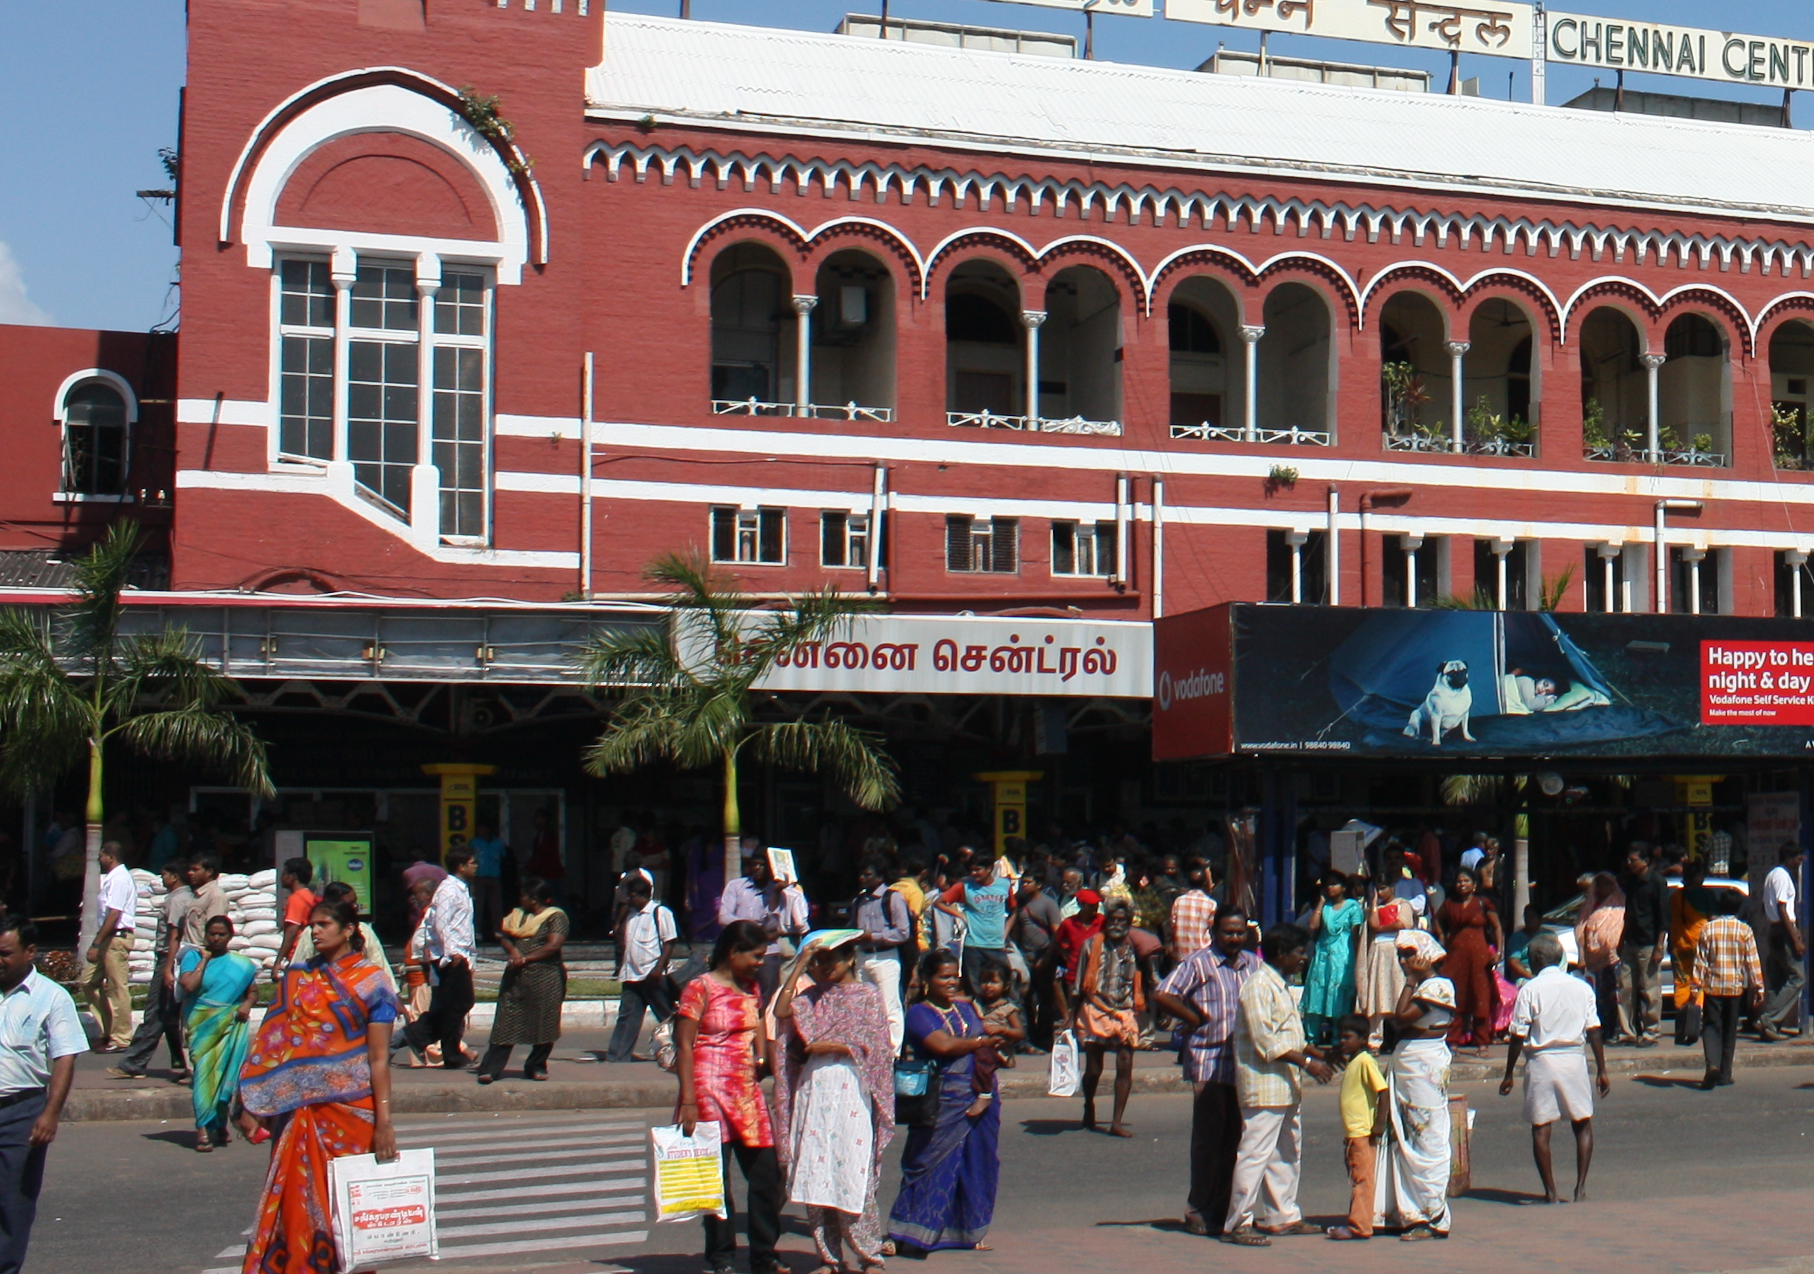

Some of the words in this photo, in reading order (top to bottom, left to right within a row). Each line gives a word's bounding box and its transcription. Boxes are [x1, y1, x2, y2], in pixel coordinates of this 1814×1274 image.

[1552, 18, 1707, 75] CHENNAI
[933, 633, 1118, 682] சென்ட்ரல்
[1708, 647, 1766, 669] Happy
[1769, 650, 1788, 666] to
[1173, 667, 1225, 701] vodafone
[1708, 672, 1756, 693] night
[1760, 672, 1774, 689] &
[1778, 672, 1811, 693] day
[1709, 695, 1752, 705] Vodafone
[1753, 695, 1772, 705] Self
[1773, 696, 1805, 705] Service
[1805, 741, 1811, 749] A
